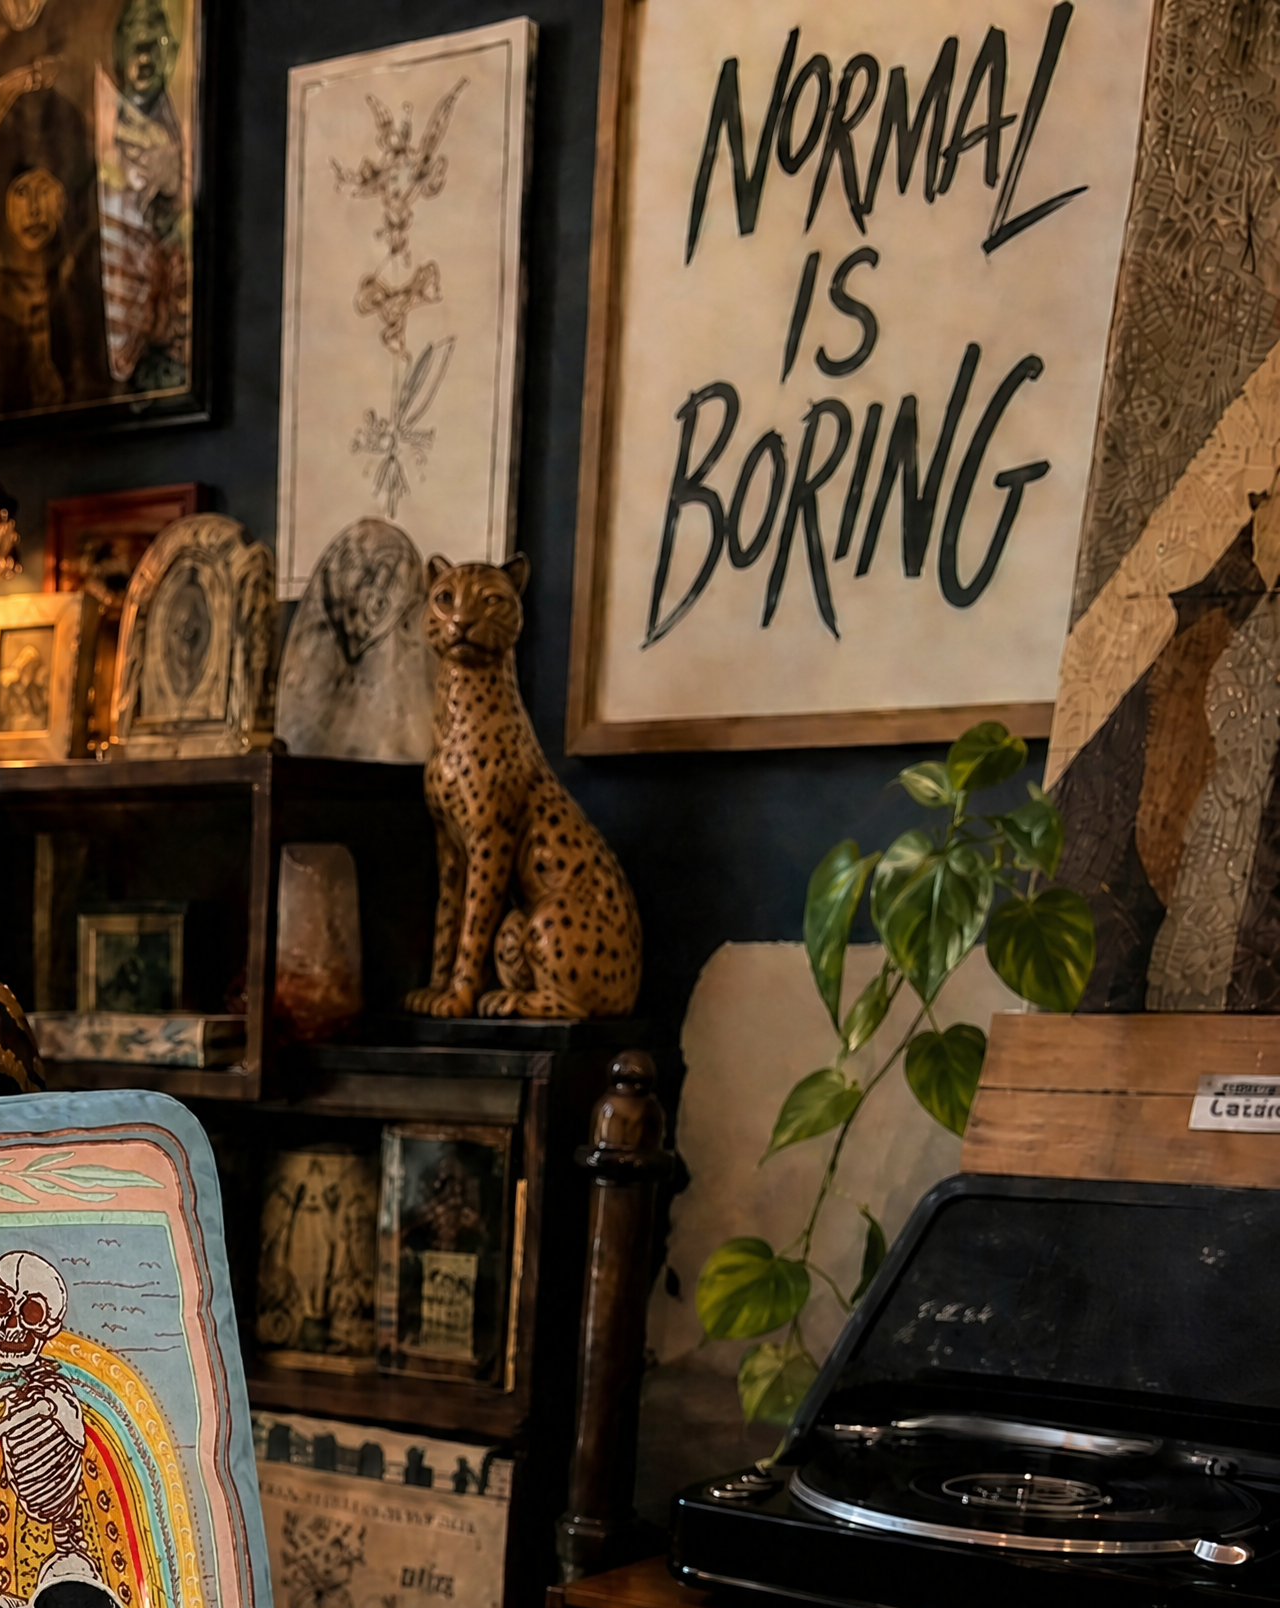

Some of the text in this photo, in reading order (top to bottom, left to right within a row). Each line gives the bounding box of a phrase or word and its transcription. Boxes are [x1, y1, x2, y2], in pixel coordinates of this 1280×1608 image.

[685, 1, 1089, 265] NORMAL
[781, 246, 880, 384] IS
[641, 342, 1051, 650] BORING
